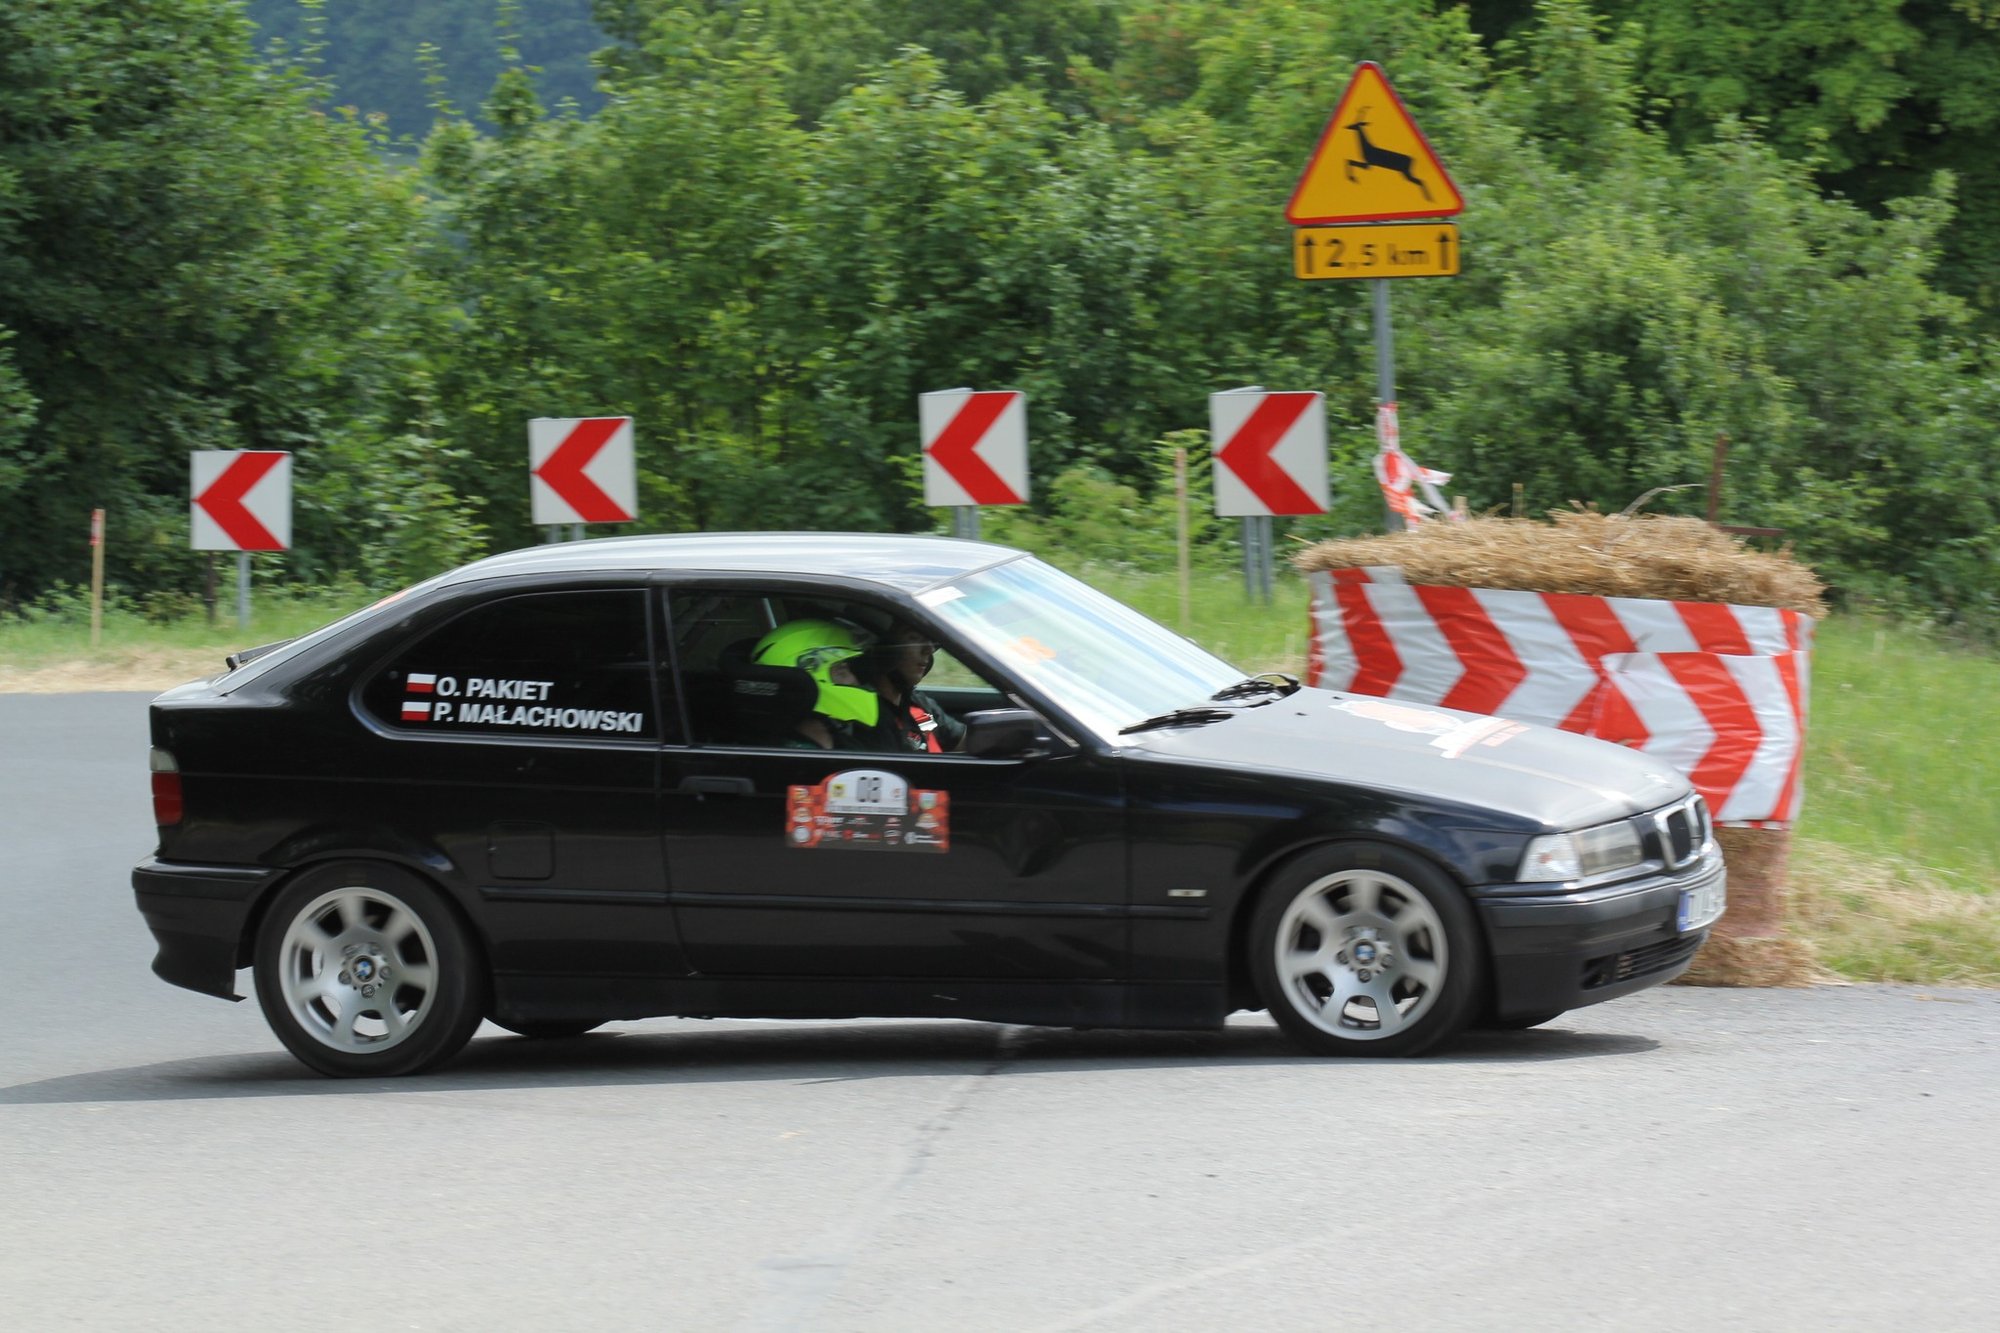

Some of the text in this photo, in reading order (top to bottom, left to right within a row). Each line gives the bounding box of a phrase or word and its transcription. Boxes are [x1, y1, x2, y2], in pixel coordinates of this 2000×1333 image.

[1386, 243, 1430, 265] km
[436, 677, 554, 701] O. PAKIET
[433, 702, 643, 733] P. MAŁACHOWSKI
